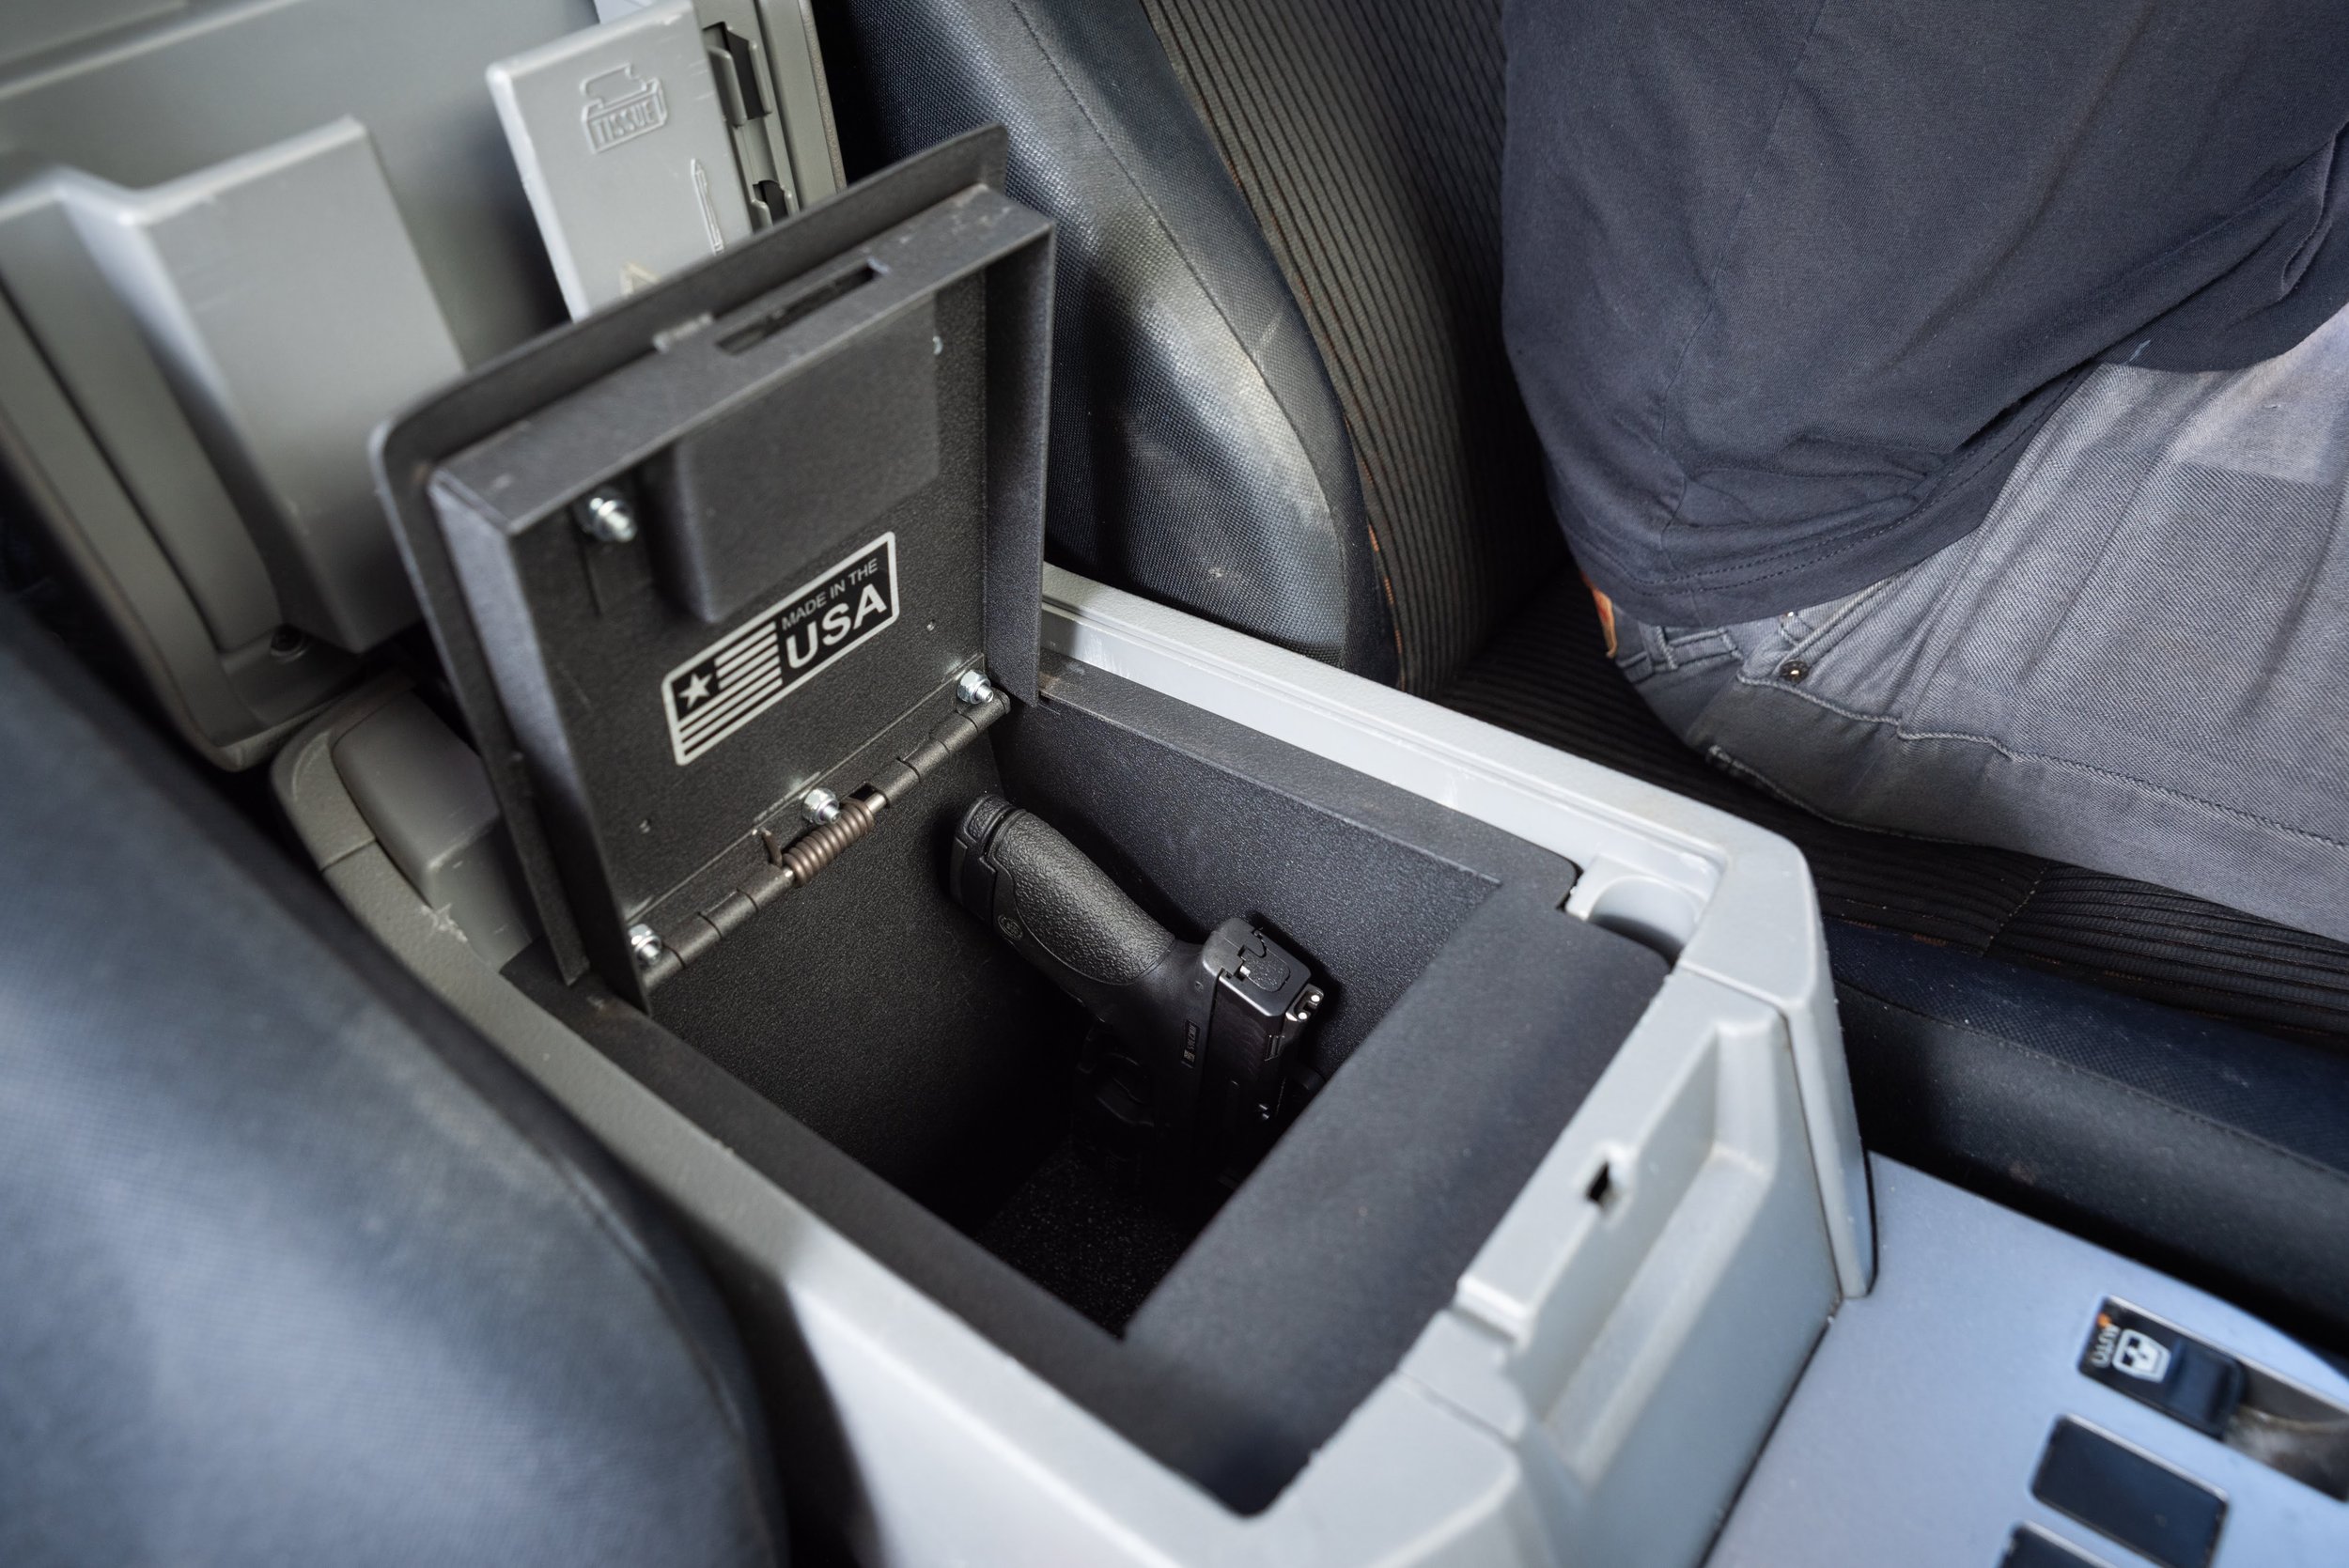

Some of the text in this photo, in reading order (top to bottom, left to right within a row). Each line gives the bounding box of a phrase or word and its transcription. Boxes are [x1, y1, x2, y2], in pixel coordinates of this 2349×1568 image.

[590, 100, 656, 144] TISSUE
[781, 558, 879, 631] MADE IN THE
[786, 583, 888, 669] USA
